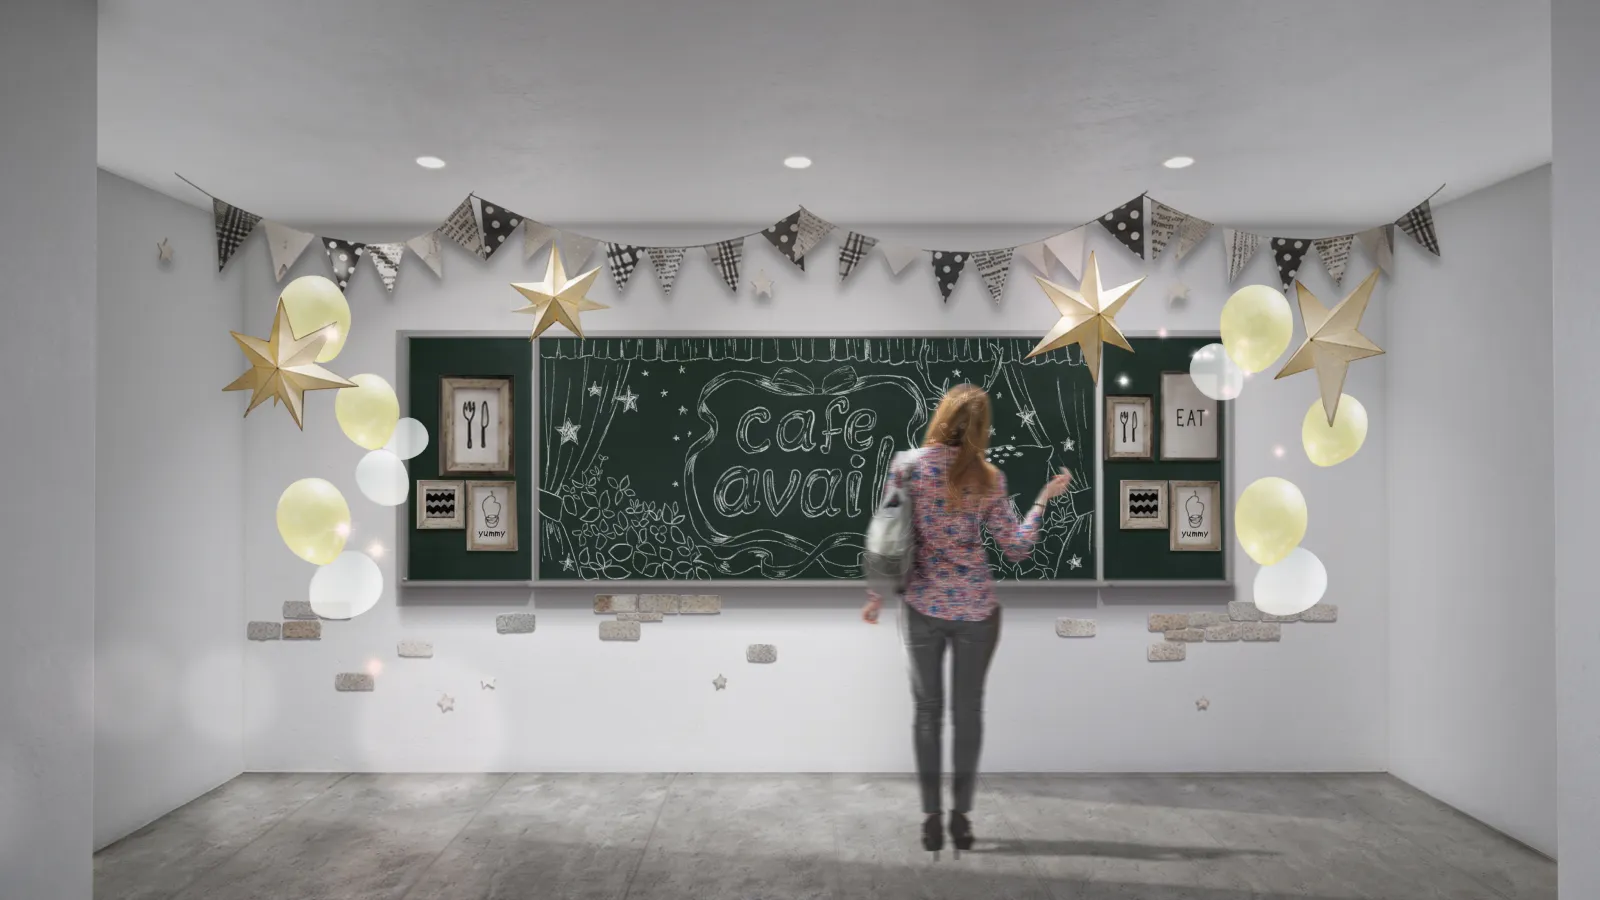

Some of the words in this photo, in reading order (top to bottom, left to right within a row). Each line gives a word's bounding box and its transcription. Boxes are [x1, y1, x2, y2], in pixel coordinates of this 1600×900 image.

[1176, 408, 1206, 427] EAT
[735, 396, 877, 454] cafe
[478, 530, 506, 539] yummy
[1181, 530, 1209, 539] yummy
